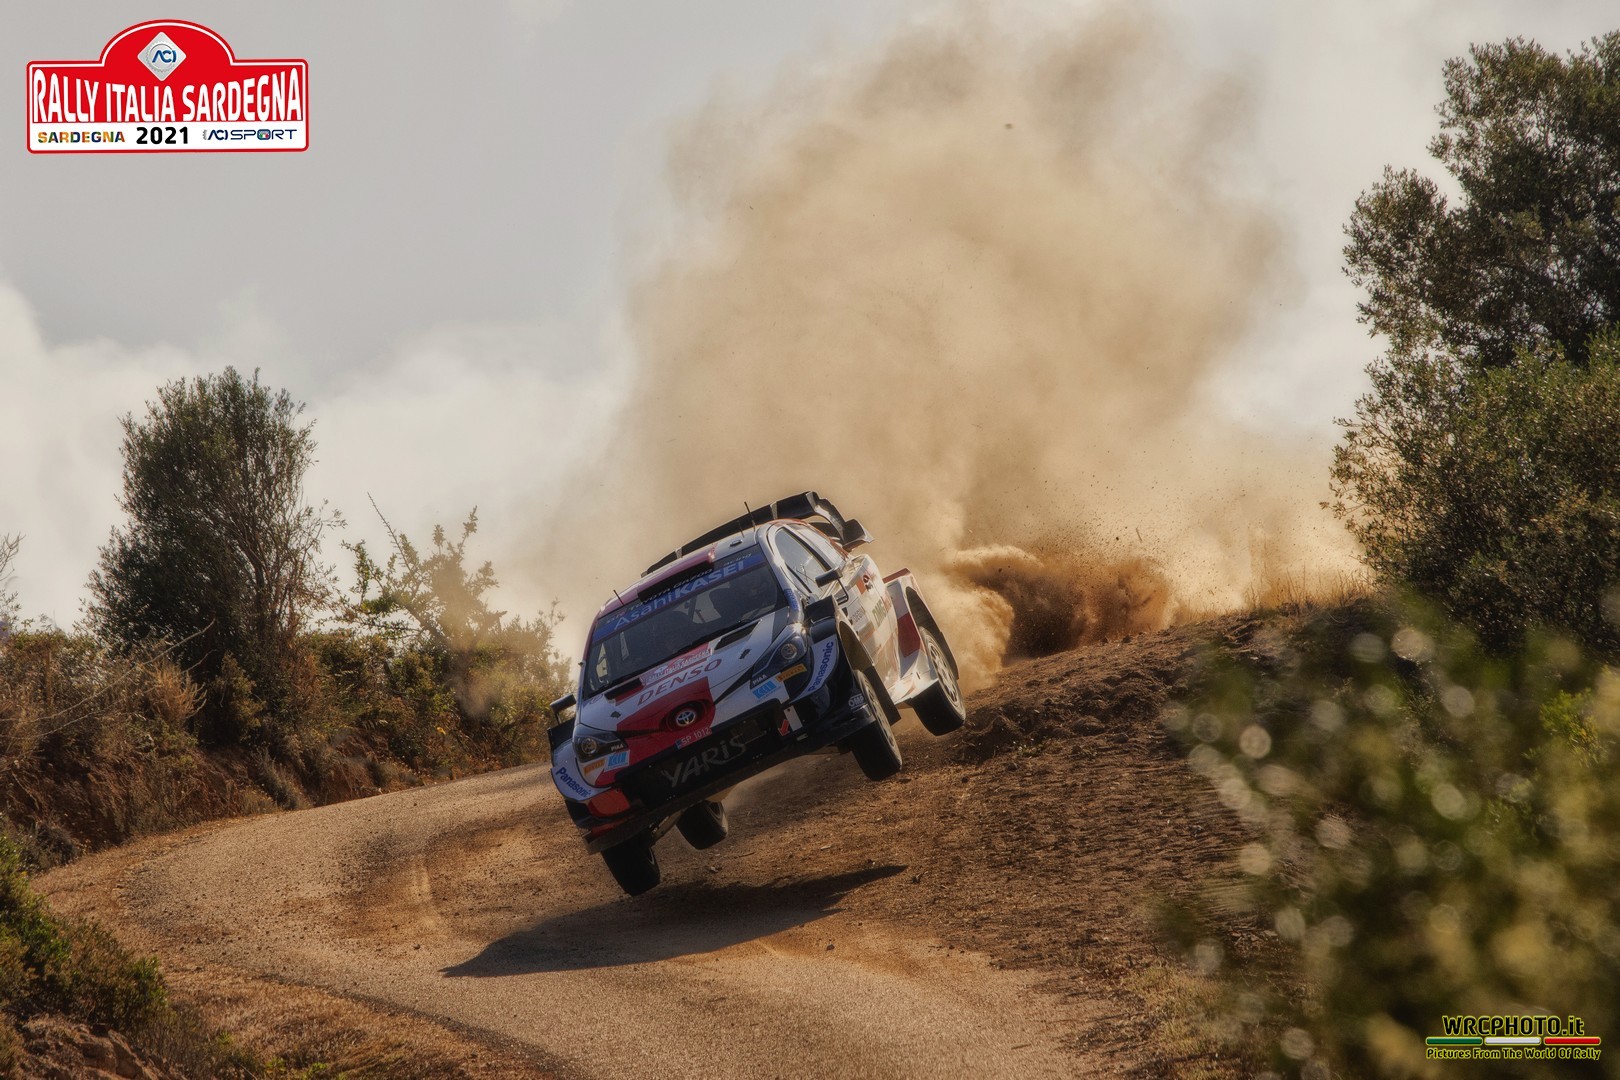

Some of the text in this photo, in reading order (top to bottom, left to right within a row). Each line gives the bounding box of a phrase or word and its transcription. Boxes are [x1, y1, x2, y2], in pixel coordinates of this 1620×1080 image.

[752, 674, 768, 685] PIAA
[807, 640, 834, 692] Panasonic
[637, 658, 722, 706] DENSO
[680, 734, 692, 746] SP
